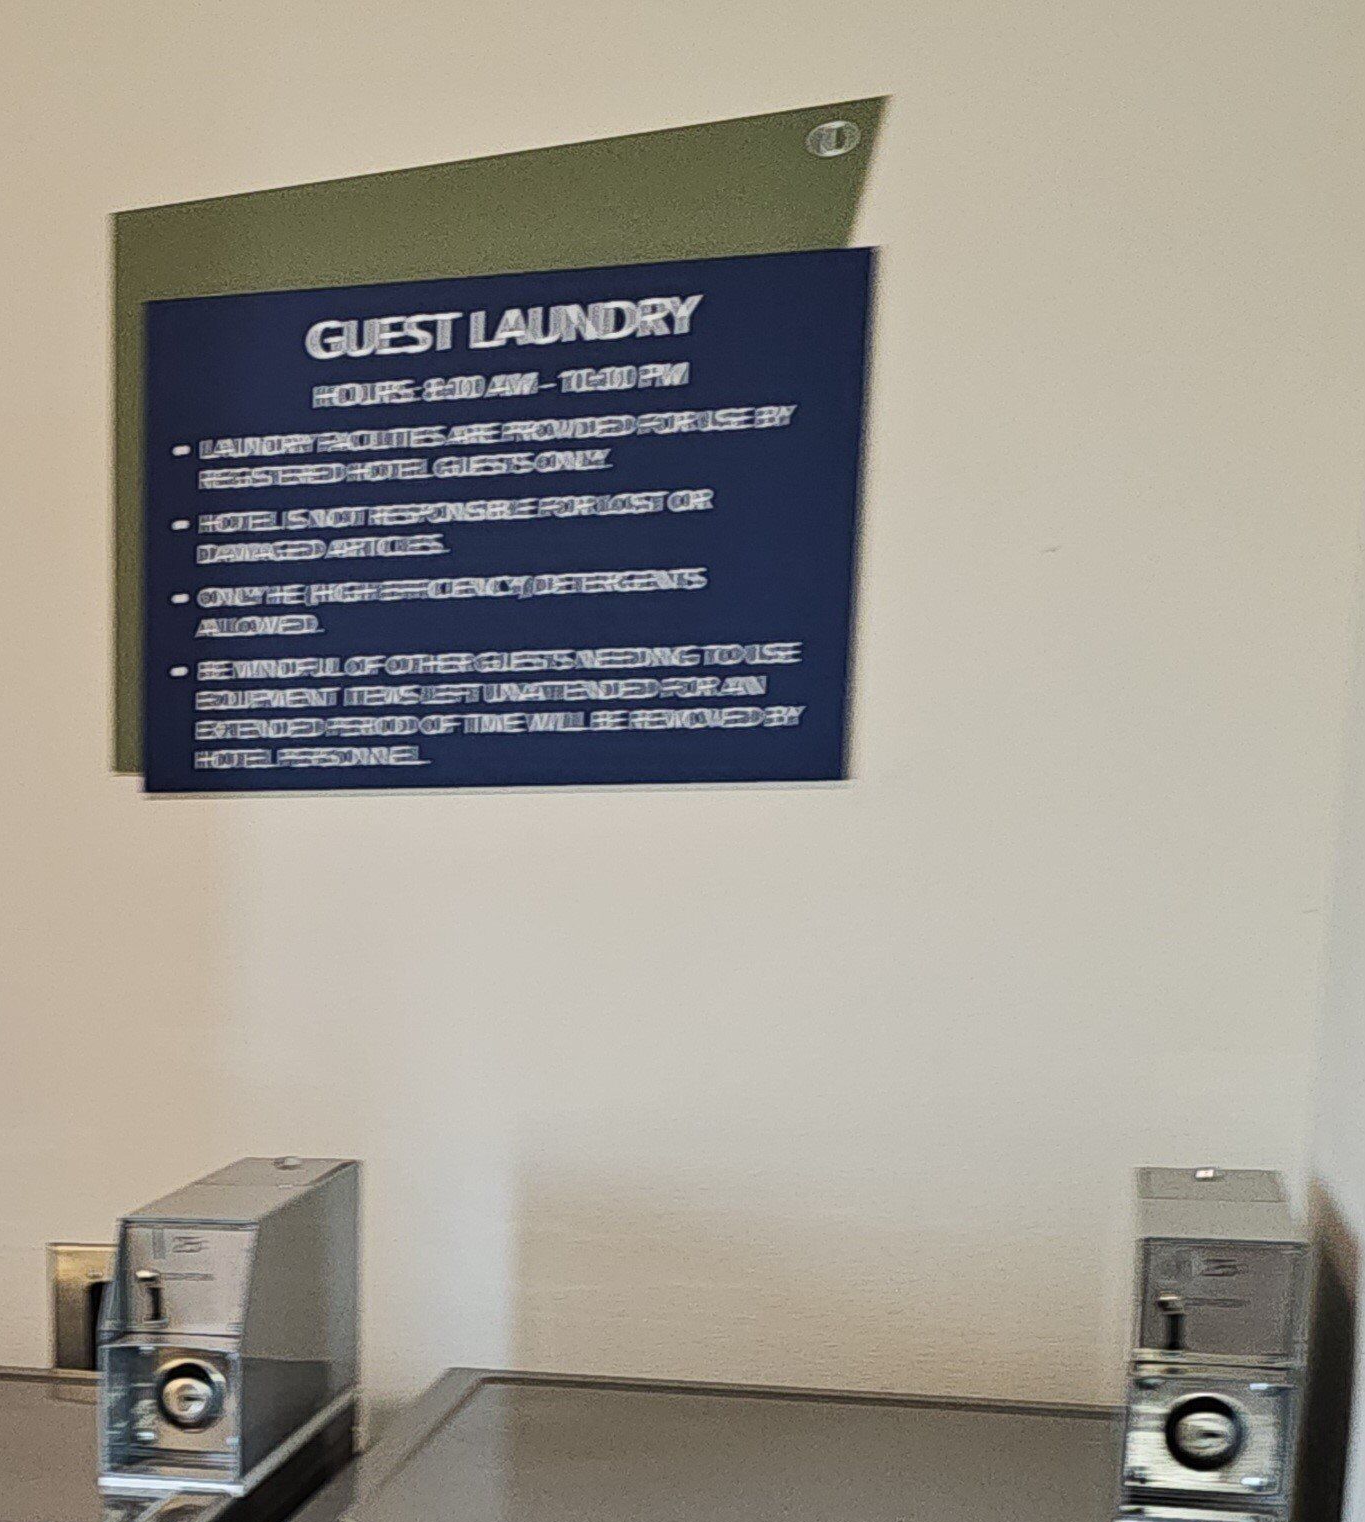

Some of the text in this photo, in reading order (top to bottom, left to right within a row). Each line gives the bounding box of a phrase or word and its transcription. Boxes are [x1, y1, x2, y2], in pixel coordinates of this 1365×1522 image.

[305, 294, 704, 360] GUEST LAUNDRY
[312, 378, 423, 408] HOURS:
[484, 371, 539, 398] AM
[638, 362, 690, 388] PM
[199, 405, 797, 458] LAUNDRY FACILITIES ARE PROVIDED FOR USE BY
[199, 463, 347, 488] REGISTERED
[346, 459, 434, 481] HOTEL
[433, 454, 535, 477] GUESTS
[198, 489, 714, 532] HOTEL IS NOT RESPONSIBLE FOR LOST OR
[196, 540, 327, 563] DAMAGED
[197, 587, 268, 607] ONLY
[197, 642, 802, 680] BE MINDFUL OF OTHER GUESTS NEEDING TO USE
[343, 685, 422, 706] ITEMS
[420, 683, 483, 704] LEFT
[482, 679, 661, 703] UNATTENDED
[659, 677, 723, 698] FOR
[720, 676, 768, 695] AN
[195, 706, 807, 739] EXTENDED PERIOD OF TIME WILL BE REMOVED BY
[194, 750, 278, 768] HOTEL
